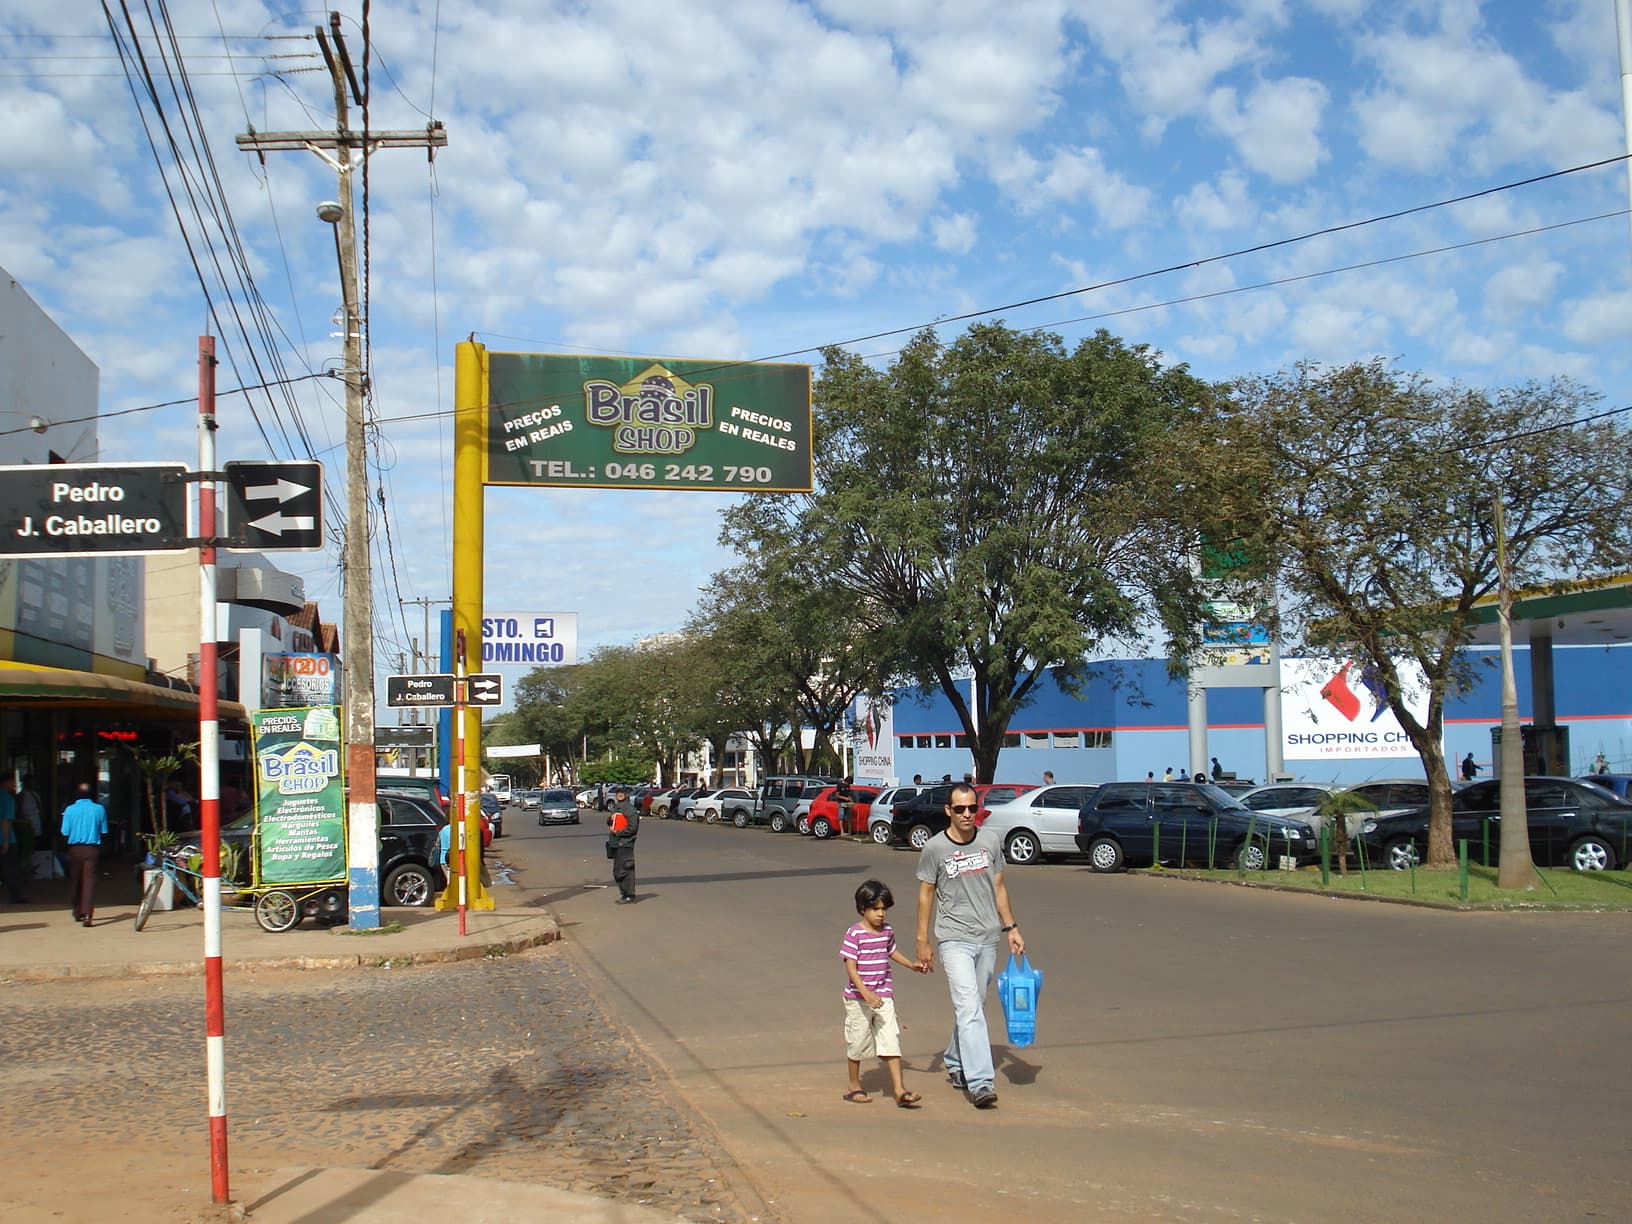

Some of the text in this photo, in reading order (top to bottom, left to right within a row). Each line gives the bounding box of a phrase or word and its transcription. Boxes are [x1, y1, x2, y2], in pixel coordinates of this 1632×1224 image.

[587, 382, 711, 425] Brasil
[503, 404, 562, 433] PREÇOS
[731, 406, 793, 432] PRECIOS
[504, 420, 574, 452] EM REAIS
[617, 426, 692, 451] SHOP
[719, 421, 797, 452] EN REALES
[529, 460, 773, 483] TEL.: 046 242 790
[53, 482, 124, 502] Pedro
[17, 514, 161, 536] J. Caballero
[482, 618, 523, 638] STO.
[482, 642, 564, 662] OMINGO
[407, 680, 433, 688] Pedro
[395, 692, 446, 701] J. Caballero
[259, 724, 302, 734] EN REALES
[262, 716, 298, 725] PRECIOS
[1287, 732, 1378, 745] SHOPPING
[1320, 745, 1407, 753] IMPORTADOS
[264, 753, 334, 777] Brasil
[878, 755, 891, 767] CHINA
[283, 777, 325, 791] SHOP
[282, 798, 319, 806] Juguetes
[276, 836, 329, 845] Herramientas
[316, 842, 339, 850] Pesca
[271, 853, 293, 861] Ropa
[301, 850, 333, 859] Regalos
